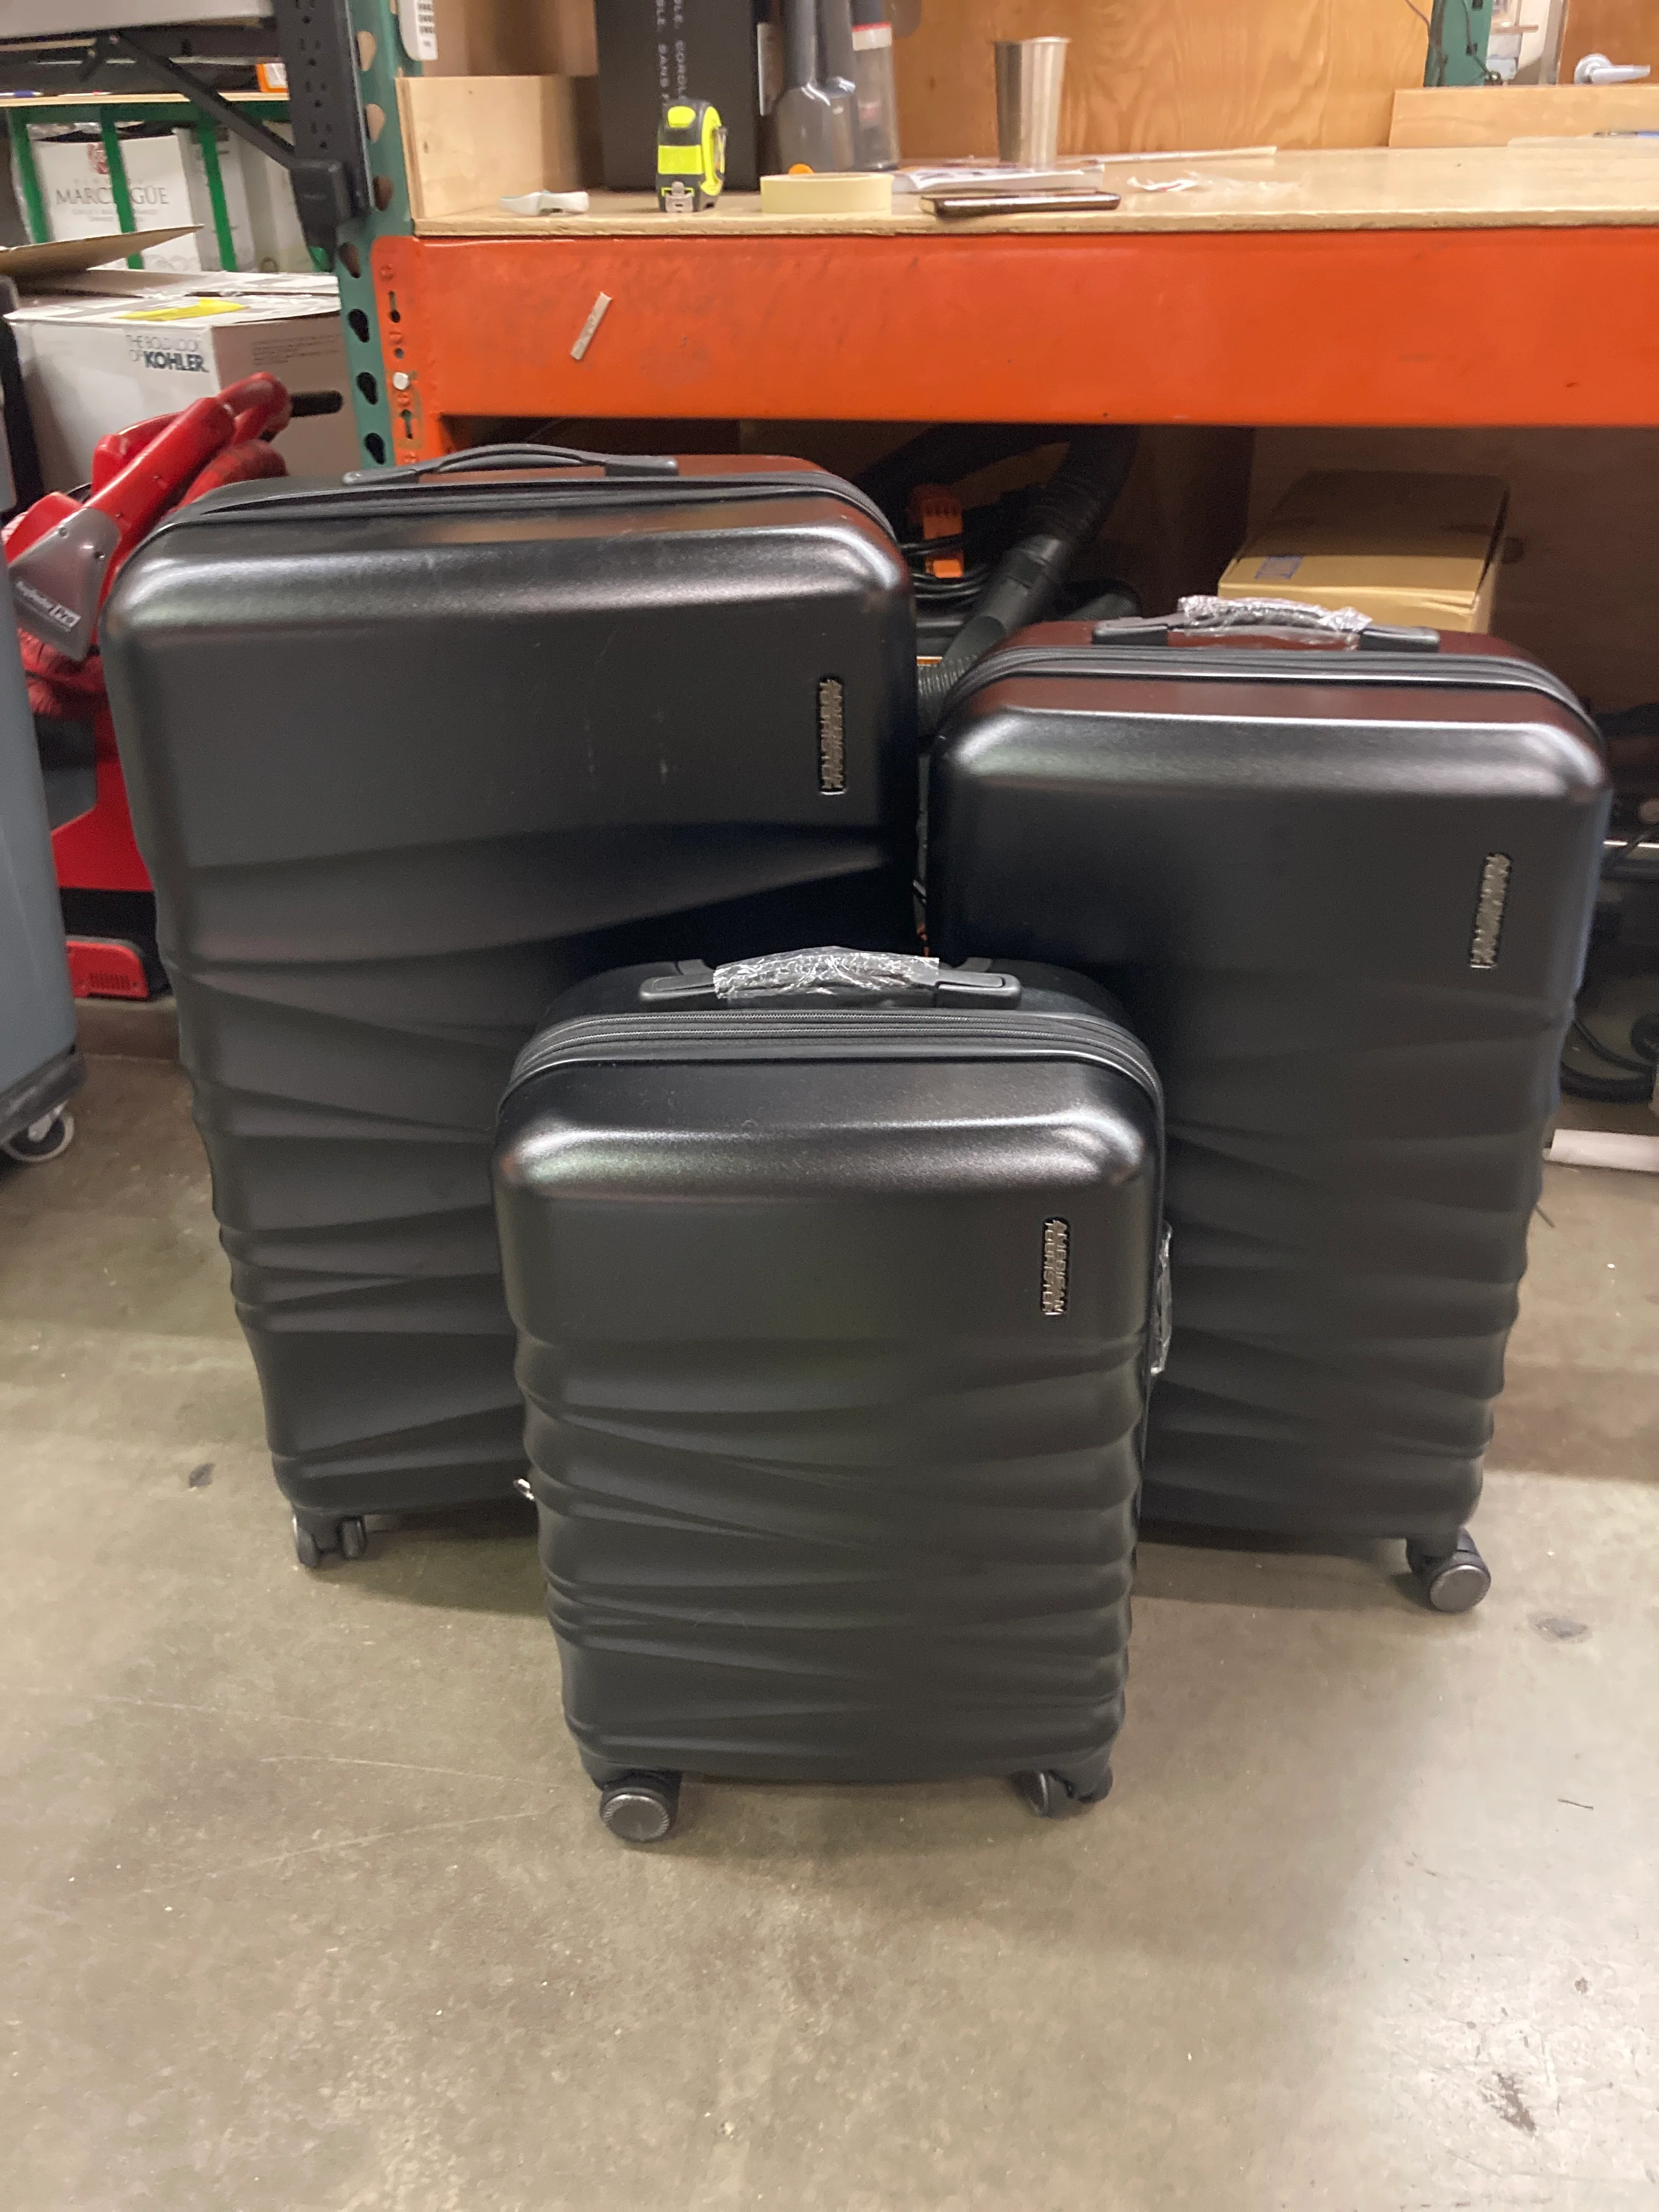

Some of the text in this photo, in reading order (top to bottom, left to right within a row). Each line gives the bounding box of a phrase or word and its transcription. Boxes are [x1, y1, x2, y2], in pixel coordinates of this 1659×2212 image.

[56, 185, 170, 205] MARCGÜE
[1042, 1221, 1055, 1312] TOURISTER
[1053, 1220, 1068, 1312] AMERICAN
